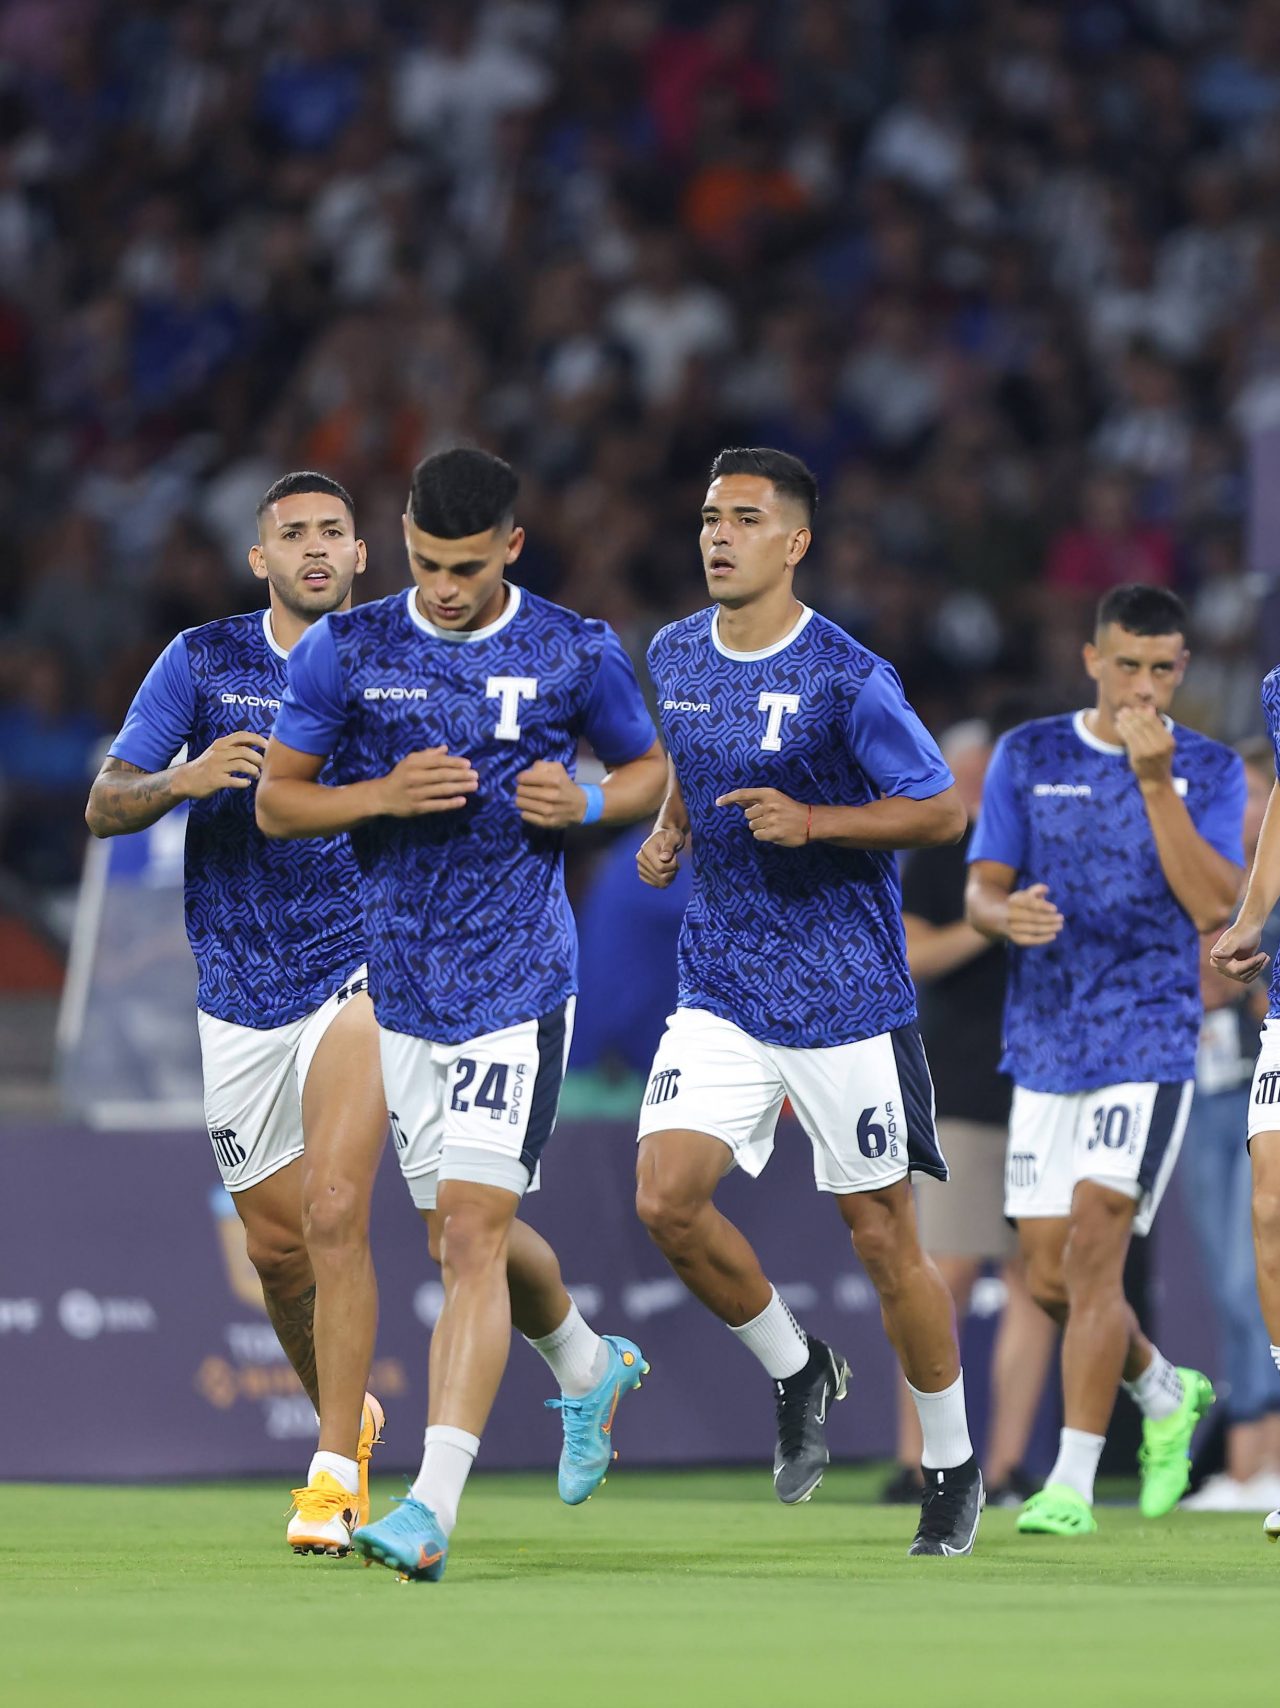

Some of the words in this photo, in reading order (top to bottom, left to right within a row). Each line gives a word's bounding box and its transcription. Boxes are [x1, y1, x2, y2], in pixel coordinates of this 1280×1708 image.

[221, 693, 281, 710] GIVOVA
[363, 687, 428, 700] GIVOVA
[485, 676, 538, 741] T
[757, 692, 800, 752] T
[1033, 783, 1092, 798] GIVOVA
[450, 1058, 509, 1120] 24
[508, 1063, 527, 1125] GIVOVA
[856, 1106, 887, 1159] 6
[885, 1101, 898, 1157] GIVOVA
